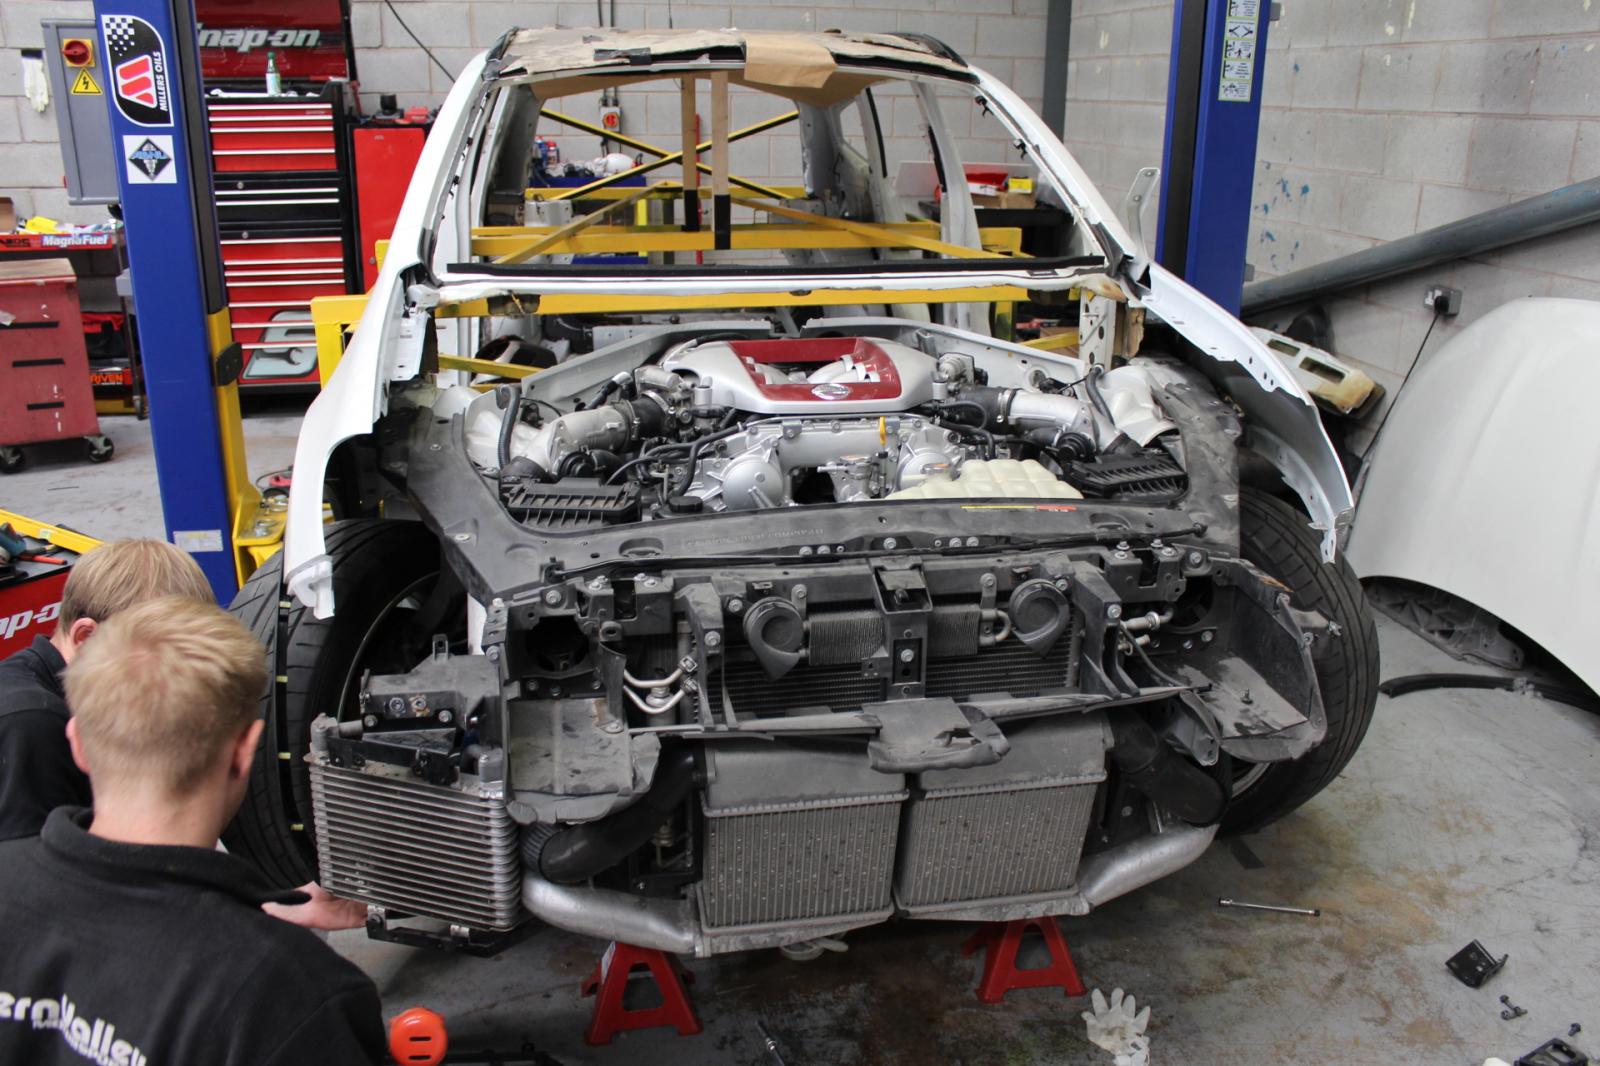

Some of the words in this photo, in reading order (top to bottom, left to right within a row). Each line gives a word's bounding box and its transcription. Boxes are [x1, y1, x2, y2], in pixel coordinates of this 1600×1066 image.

[197, 22, 320, 53] nap-on
[153, 51, 164, 73] OILS
[156, 74, 168, 112] MILLERS
[41, 234, 109, 248] MagnaFuel
[90, 373, 123, 384] RIVEN
